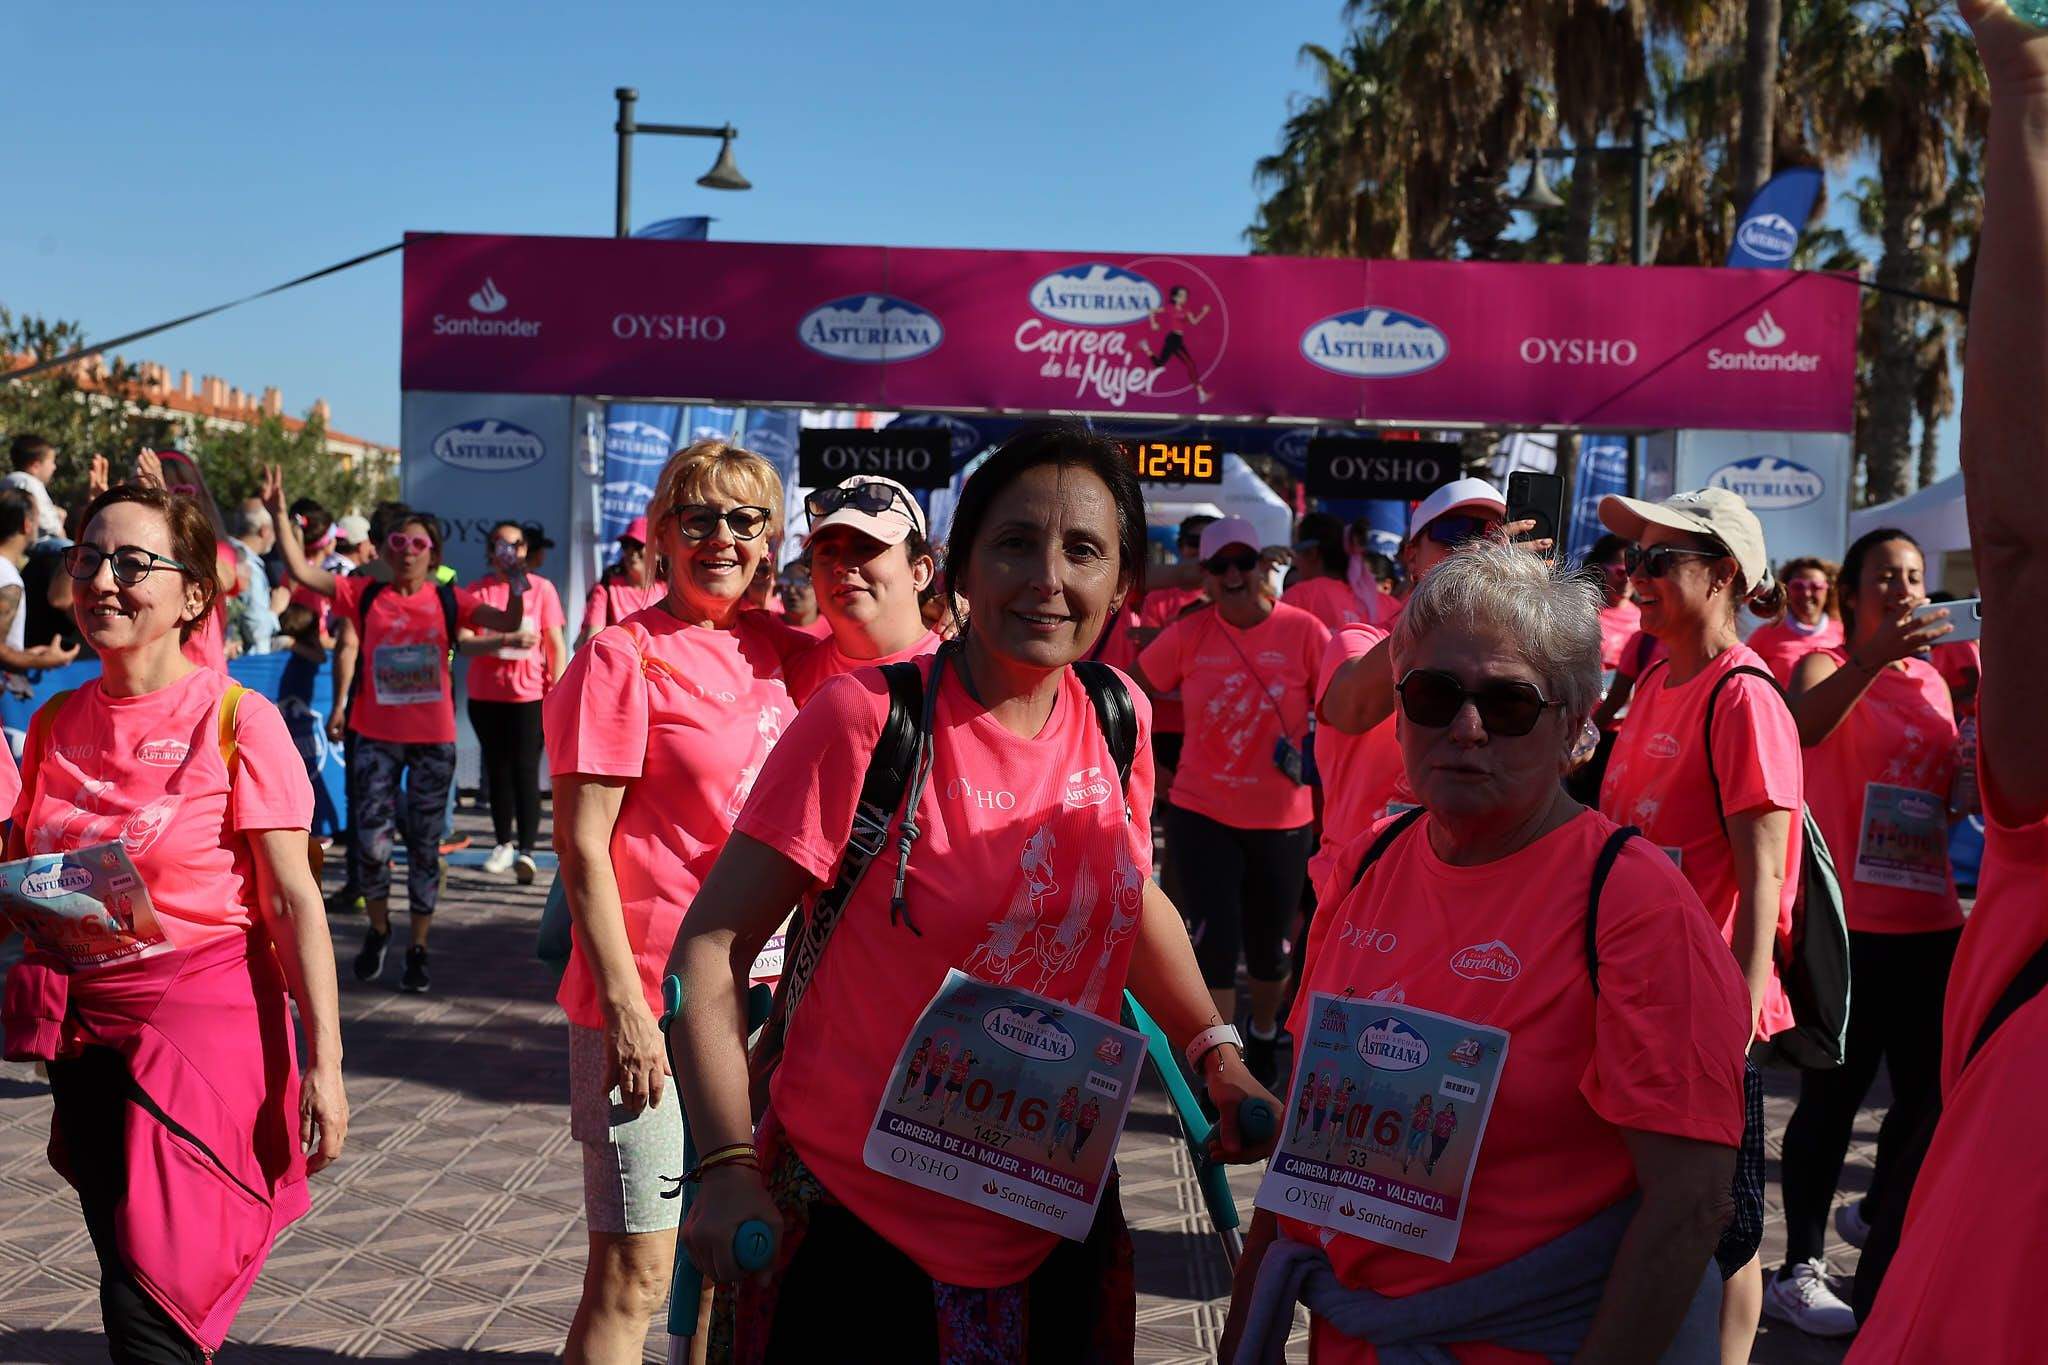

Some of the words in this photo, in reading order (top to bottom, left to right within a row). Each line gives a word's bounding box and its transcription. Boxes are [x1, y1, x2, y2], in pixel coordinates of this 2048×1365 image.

[1040, 285, 1151, 310] ASTURIANA
[433, 314, 542, 338] Santander
[612, 313, 726, 340] OYSHO
[810, 316, 931, 345] ASTURIANA
[1014, 318, 1130, 354] Carrera
[1313, 332, 1436, 360] ASTURIANA
[1520, 337, 1638, 366] OYSHO
[1707, 348, 1820, 372] Santander
[1040, 355, 1062, 377] de
[1064, 355, 1082, 378] la
[1075, 351, 1167, 406] Mujer
[442, 436, 537, 459] ASTURIANA
[822, 445, 931, 471] OYSHO
[1138, 443, 1213, 478] 12:46
[1328, 455, 1441, 483] OYSHO
[1719, 475, 1815, 497] ASTURIANA
[26, 875, 91, 894] ASTURIANA
[986, 1012, 1068, 1058] ASTURIANA
[965, 1078, 1049, 1132] 016
[974, 1125, 1012, 1149] 1427
[889, 1117, 942, 1146] CARRERA
[943, 1136, 959, 1152] DE
[961, 1142, 976, 1159] LA
[978, 1147, 1020, 1173] MUJER
[1030, 1165, 1085, 1197] VALENCIA
[891, 1146, 959, 1182] OYSHO
[1285, 1158, 1329, 1181] CARRERA
[1386, 1183, 1445, 1213] VALENCIA
[999, 1186, 1068, 1221] Santander
[1357, 1207, 1428, 1239] Santander
